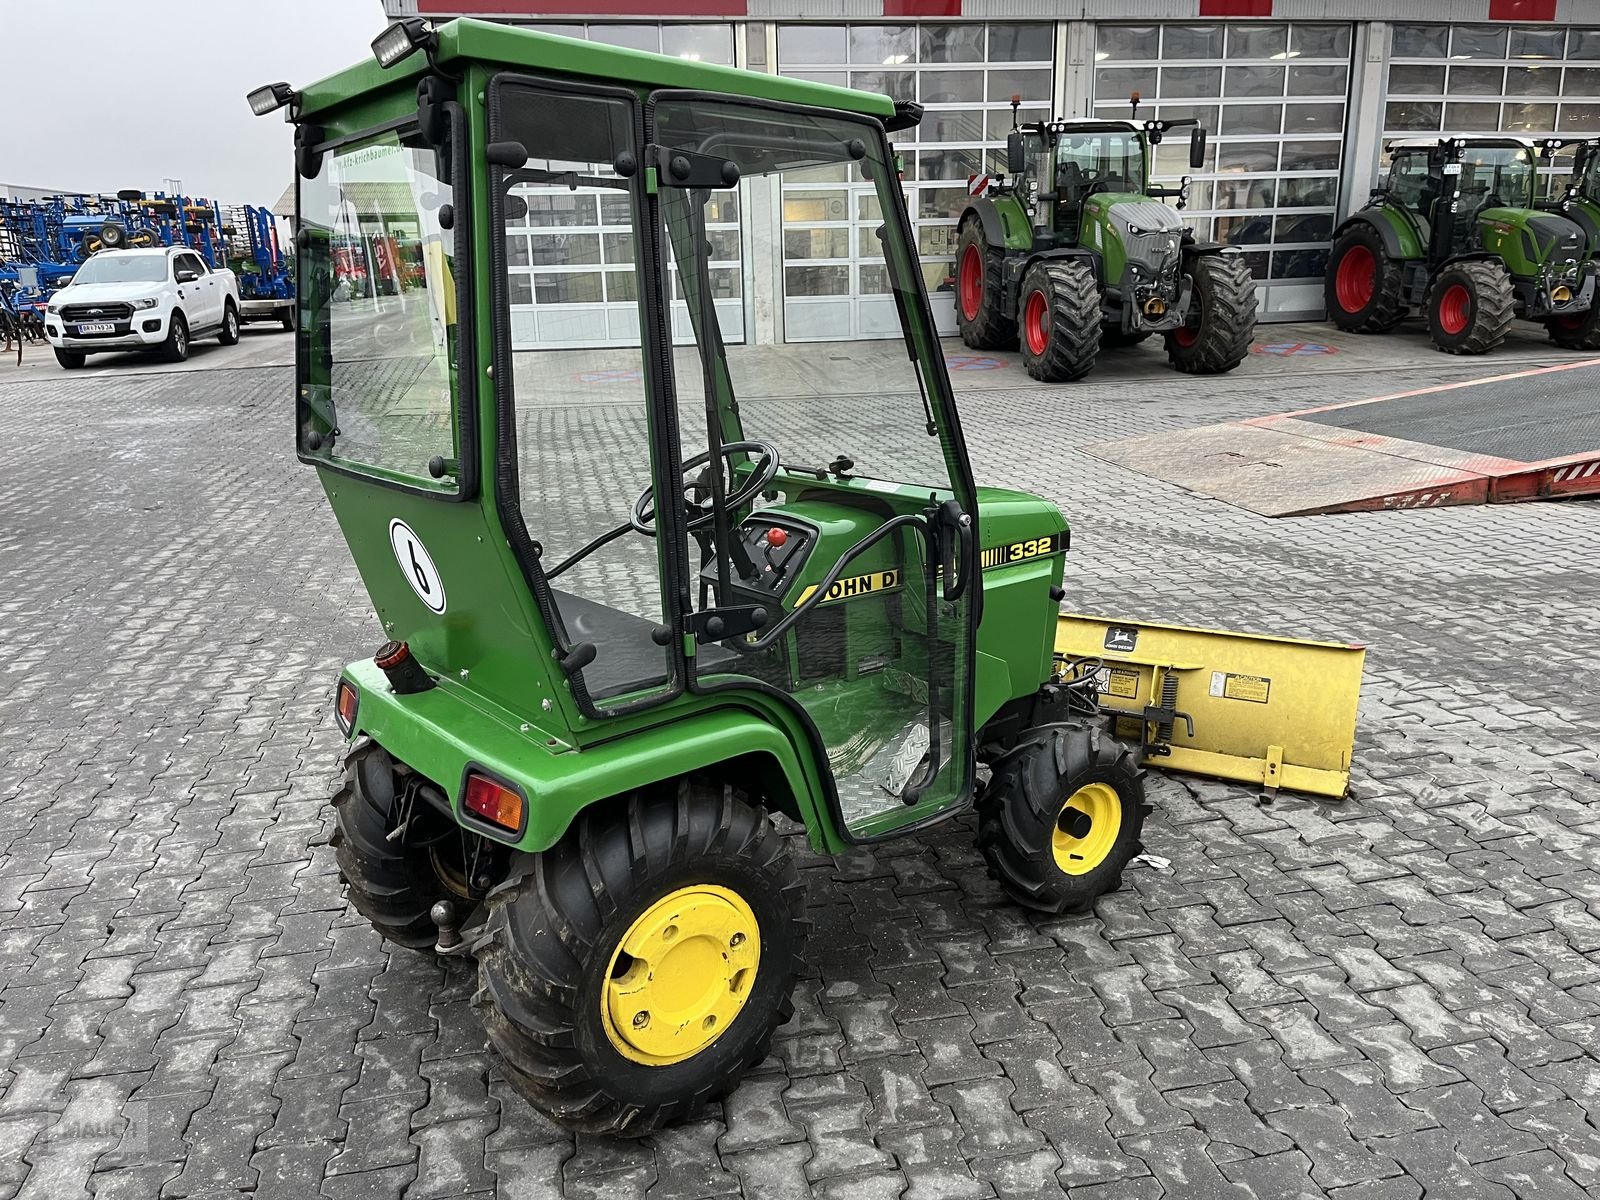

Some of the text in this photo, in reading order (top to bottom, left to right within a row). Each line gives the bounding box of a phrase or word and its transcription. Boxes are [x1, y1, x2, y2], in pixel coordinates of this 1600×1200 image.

[1009, 537, 1051, 560] 332
[407, 539, 431, 595] 6
[821, 575, 872, 599] OHN
